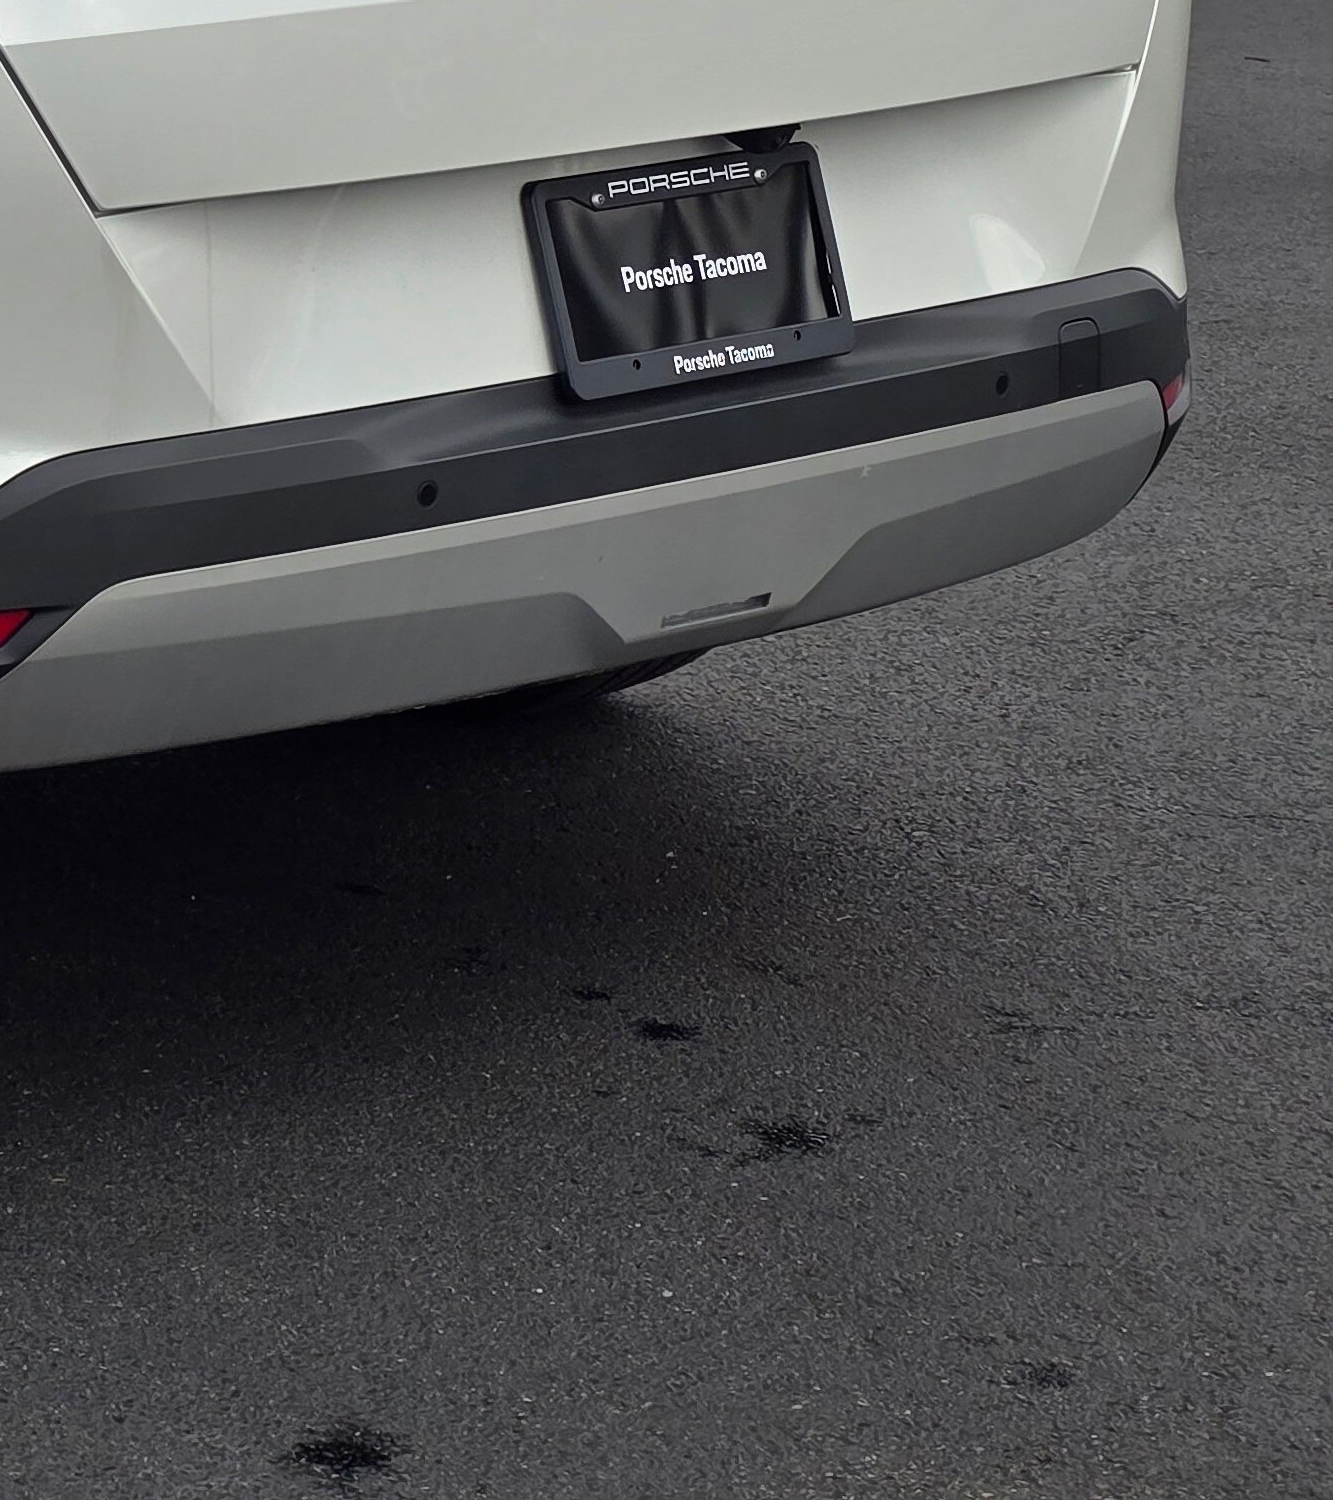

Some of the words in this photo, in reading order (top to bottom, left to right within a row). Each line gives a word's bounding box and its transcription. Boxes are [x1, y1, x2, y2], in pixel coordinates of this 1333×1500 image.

[607, 161, 751, 199] PORSCHE
[620, 258, 694, 293] Porsche
[693, 251, 768, 280] Tacoma
